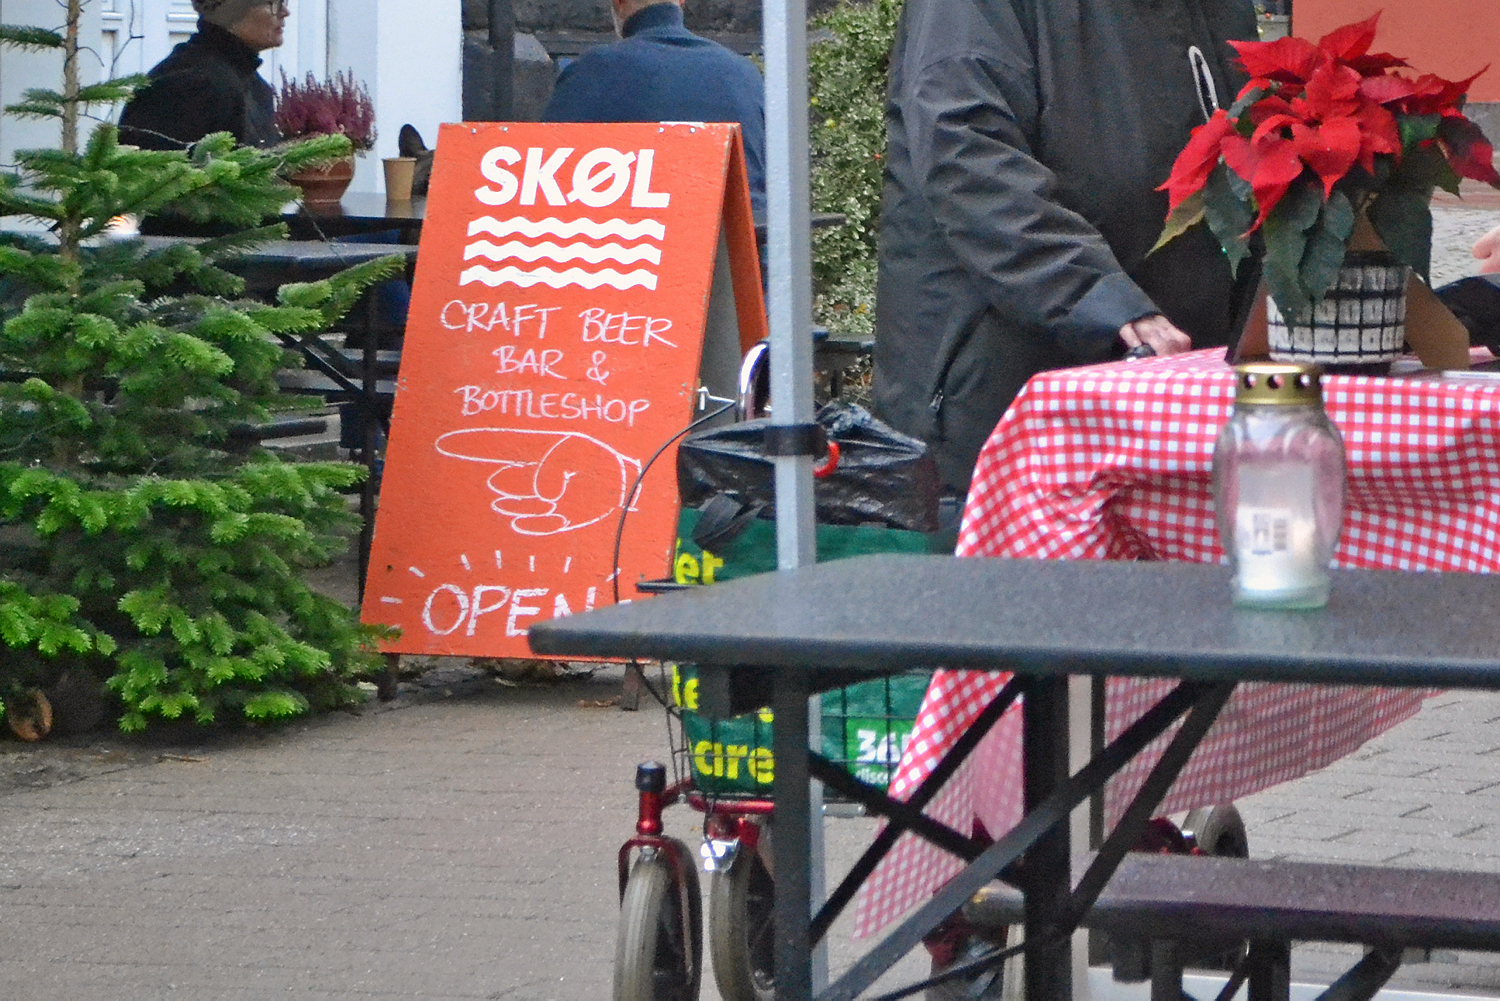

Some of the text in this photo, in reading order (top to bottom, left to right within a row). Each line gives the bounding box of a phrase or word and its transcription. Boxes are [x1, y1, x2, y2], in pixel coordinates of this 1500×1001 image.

[474, 146, 671, 208] SKØL
[440, 299, 677, 348] CRAFT BEER
[492, 345, 610, 386] BAR &
[454, 384, 651, 426] BOTTLESHOP
[674, 538, 724, 585] er
[688, 740, 775, 784] are
